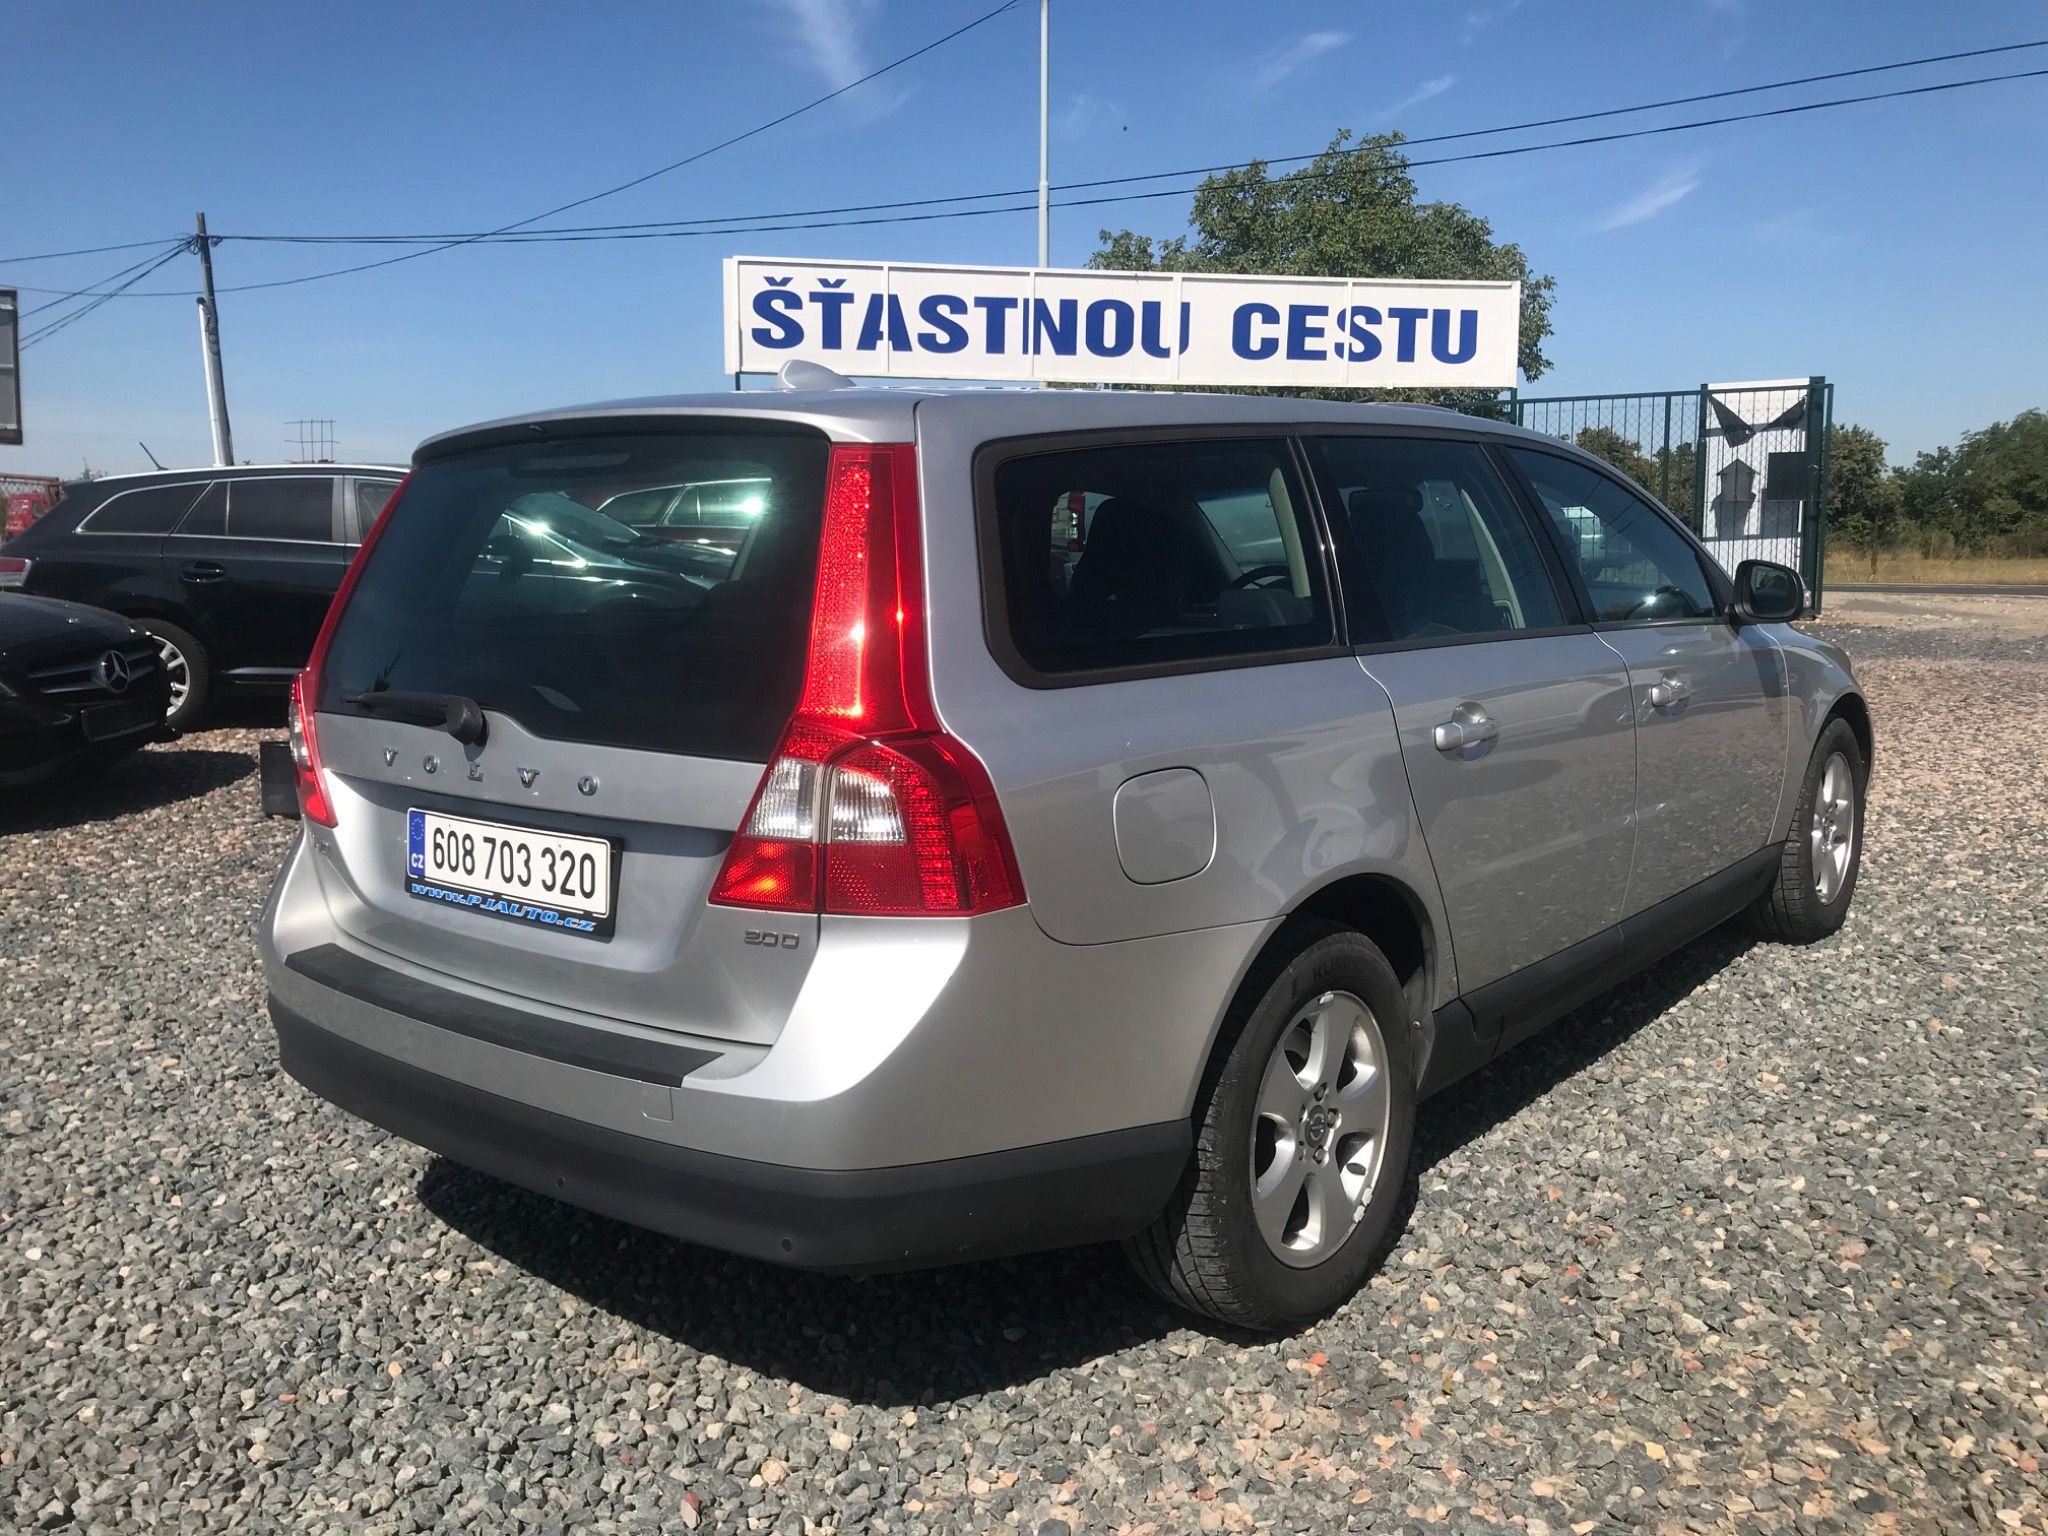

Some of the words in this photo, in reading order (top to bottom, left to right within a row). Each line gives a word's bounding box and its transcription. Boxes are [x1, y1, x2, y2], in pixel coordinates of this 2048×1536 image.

[752, 277, 1190, 357] ŠŤASTNOU
[1232, 303, 1478, 364] CESTU
[383, 747, 600, 797] VOLVO
[411, 852, 424, 869] CZ
[433, 827, 475, 876] 608
[482, 836, 531, 888] 703
[540, 846, 596, 899] 320
